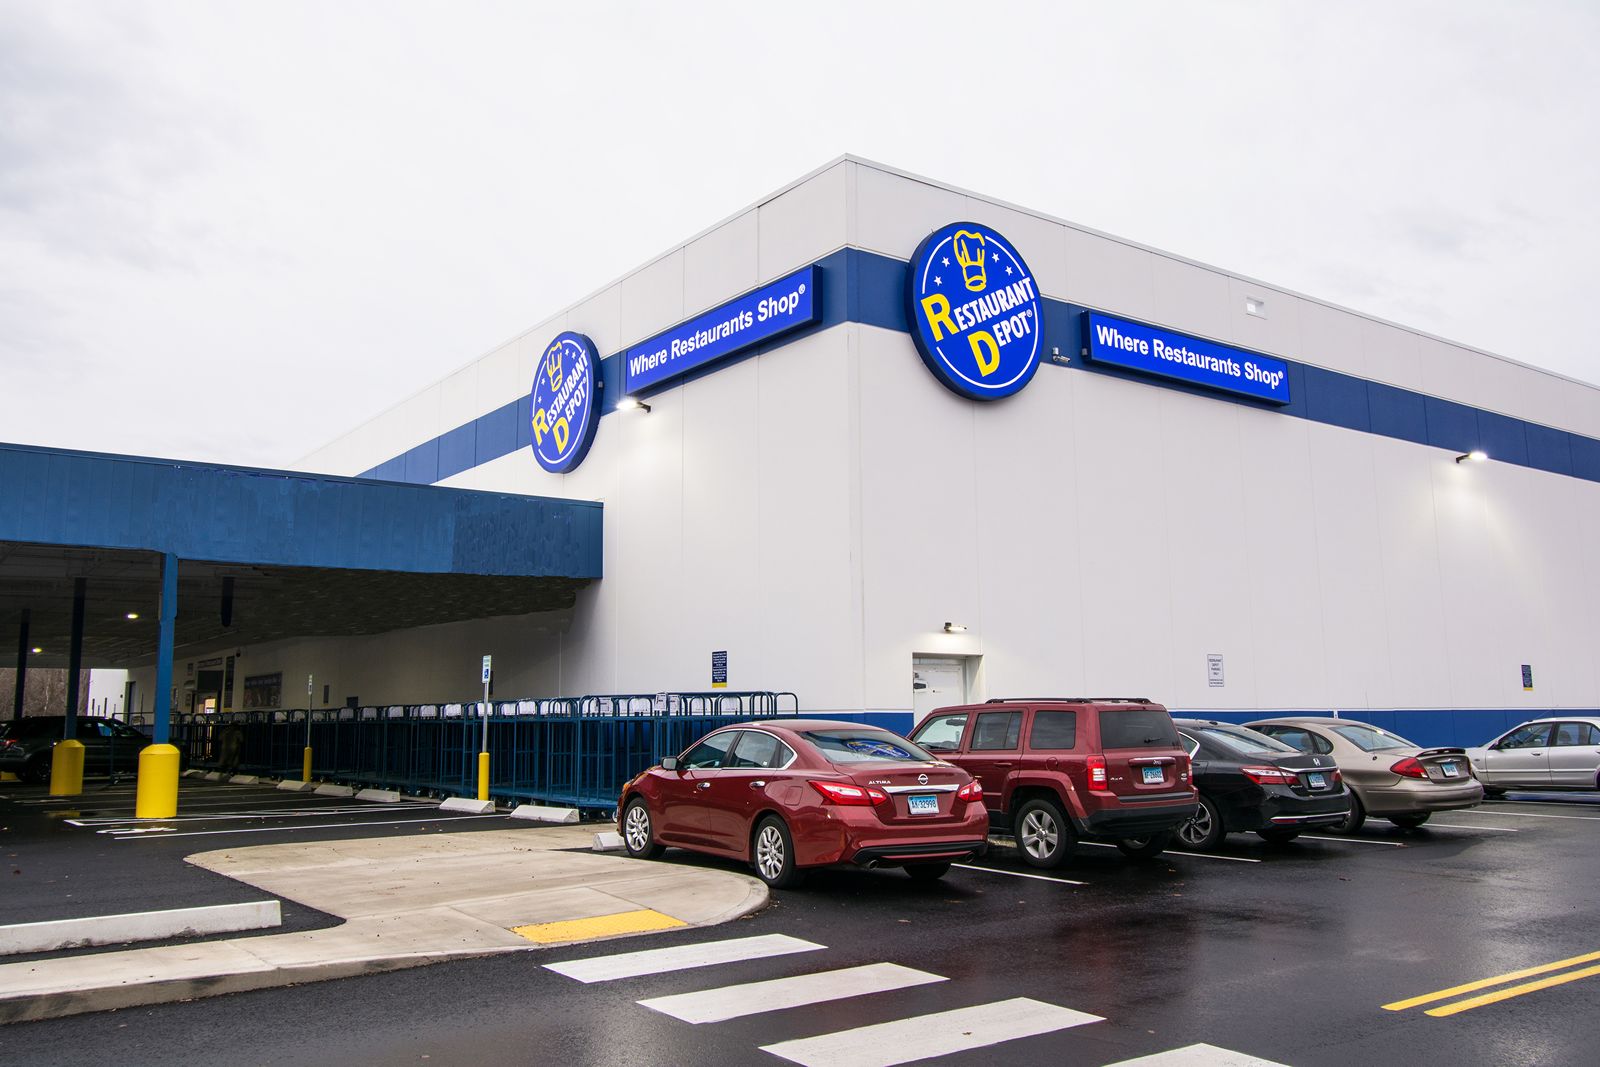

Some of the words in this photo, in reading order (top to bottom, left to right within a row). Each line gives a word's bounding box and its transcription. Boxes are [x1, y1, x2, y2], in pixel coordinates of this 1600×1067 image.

[921, 277, 1034, 342] RESTAURANT
[630, 349, 667, 377] Where
[671, 310, 753, 360] Restaurants
[1096, 324, 1149, 355] Where
[1152, 338, 1241, 377] Restaurants
[531, 349, 588, 446] RESTAURANT
